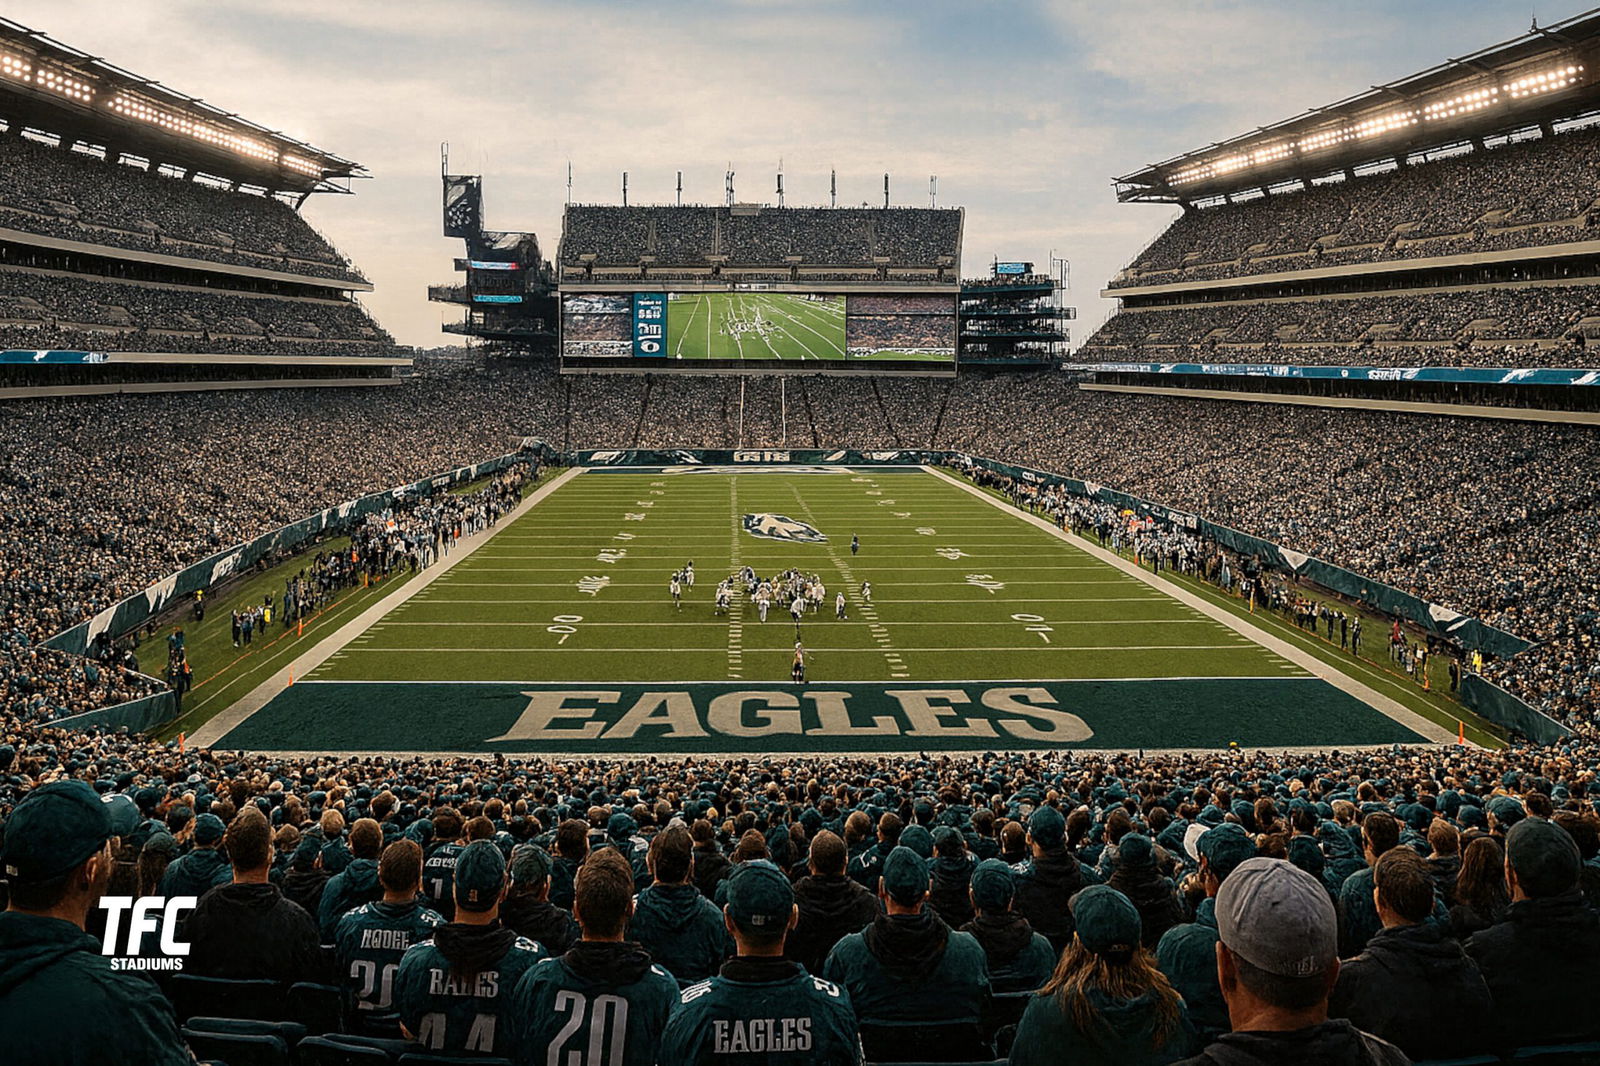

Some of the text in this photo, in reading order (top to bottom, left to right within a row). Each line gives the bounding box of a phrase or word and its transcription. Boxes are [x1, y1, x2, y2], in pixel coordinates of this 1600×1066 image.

[484, 688, 1094, 742] EAGLES
[547, 989, 629, 1066] 20
[713, 1017, 812, 1054] EAGLES
